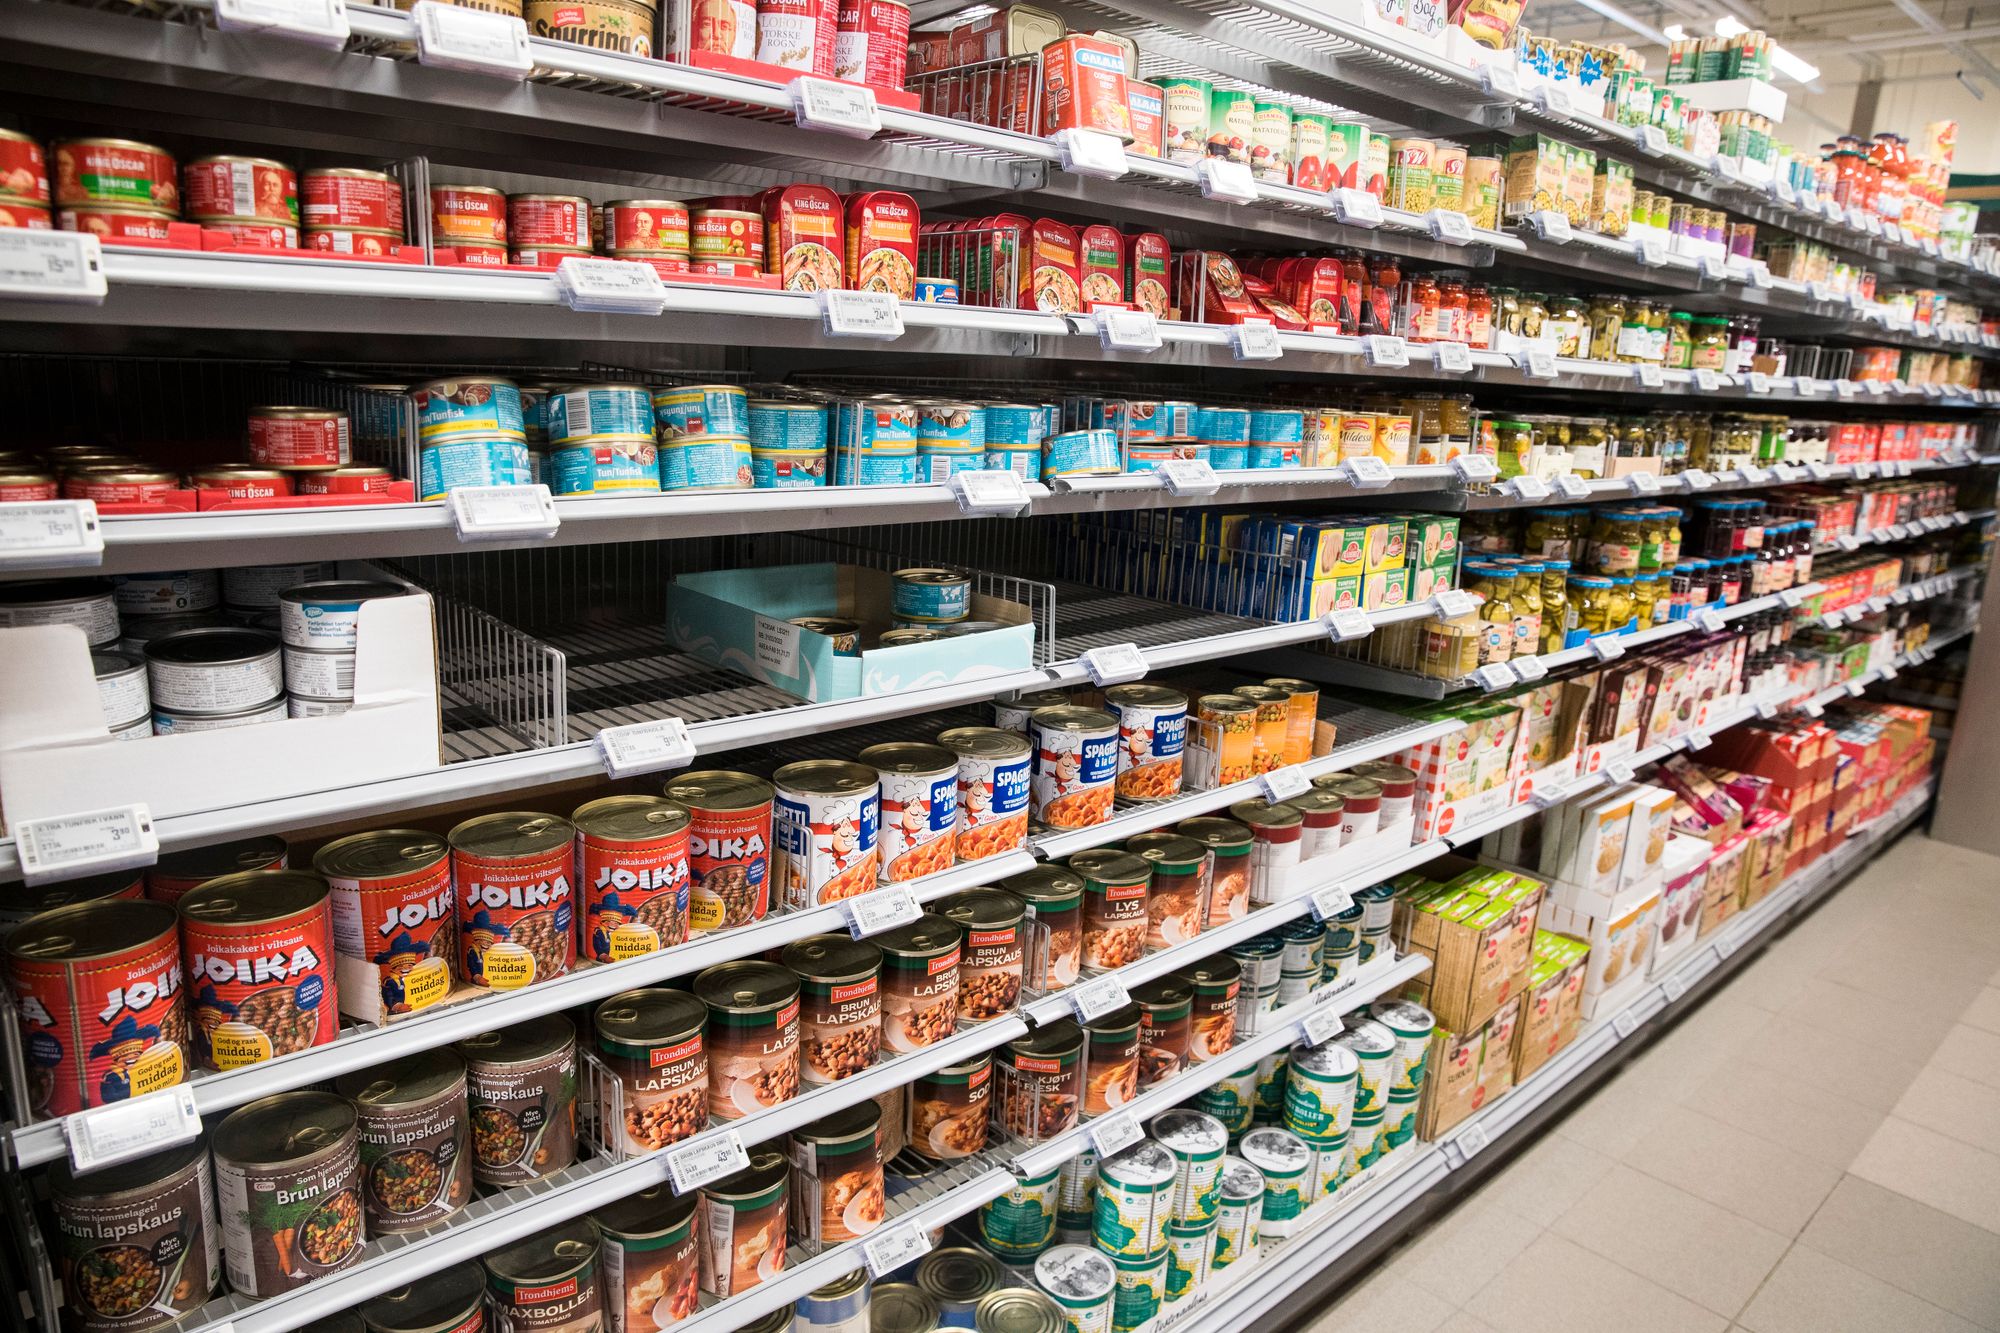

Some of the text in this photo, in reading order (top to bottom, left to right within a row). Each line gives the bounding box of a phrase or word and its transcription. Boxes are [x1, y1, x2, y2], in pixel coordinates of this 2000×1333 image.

[764, 29, 801, 41] TORSKE
[766, 38, 796, 49] ROGN
[112, 157, 146, 171] OSCAR
[445, 199, 489, 212] KING OSCAR
[794, 199, 830, 211] KING OSCAR
[875, 205, 909, 217] KING OSCAR
[124, 226, 148, 238] KING
[706, 224, 727, 233] OSCAR
[1054, 235, 1071, 246] OSCAR
[466, 254, 501, 265] KING OSCAR
[247, 487, 274, 499] OSCAR
[306, 484, 328, 494] OSCAR
[1171, 730, 1178, 741] la
[1102, 756, 1108, 767] la
[984, 814, 998, 823] Gino
[732, 824, 759, 834] viltsaus
[921, 832, 935, 841] Gino
[613, 848, 685, 866] Joikakaker viltsaus
[483, 866, 563, 883] Joikakaker viltsaus
[594, 857, 689, 891] JOIKA
[402, 882, 442, 902] Joikakaker
[467, 875, 571, 909] JOIKA
[1109, 887, 1146, 899] Trondhjems
[1115, 900, 1139, 912] LYS
[1104, 908, 1145, 920] LAPSKAUS
[206, 934, 304, 953] Joikakaker viltsaus
[971, 932, 1014, 944] Trondhjems
[614, 942, 652, 953] middag
[977, 946, 1006, 956] BRUN
[192, 945, 321, 984] JOIKA
[487, 963, 527, 974] middag
[411, 967, 443, 984] God rask
[936, 967, 957, 982] BRUN
[410, 975, 445, 996] middag
[834, 981, 877, 999] Trondhjems
[431, 988, 443, 997] min!
[840, 998, 870, 1012] BRUN
[217, 1036, 258, 1045] God rask
[217, 1045, 261, 1059] middag
[654, 1041, 701, 1062] Trondhjems
[137, 1053, 176, 1076] God rask
[661, 1059, 695, 1077] BRUN
[1017, 1058, 1058, 1071] Trondhjems
[137, 1061, 178, 1089] middag
[1038, 1072, 1072, 1085] KJØTT
[477, 1077, 524, 1087] hjemmelaget!
[480, 1085, 544, 1103] lapskaus
[523, 1114, 541, 1124] kjøtt!
[525, 1109, 540, 1118] Mye
[368, 1111, 439, 1131] Som hjemmelaget!
[391, 1115, 456, 1145] lapskaus
[440, 1140, 453, 1151] Mye
[439, 1146, 455, 1161] kjøtt!
[296, 1175, 316, 1185] Som
[277, 1185, 320, 1205] Brun
[71, 1203, 158, 1223] Som hjemmelaget!
[415, 1208, 443, 1222] MINUTTER!
[60, 1206, 183, 1242] Brun lapskaus
[158, 1240, 181, 1256] kjøtt!
[160, 1237, 178, 1249] Mye
[519, 1283, 575, 1301] Trondhjems
[129, 1312, 164, 1326] MINUTTER!
[527, 1312, 572, 1326] TOMATSAUS
